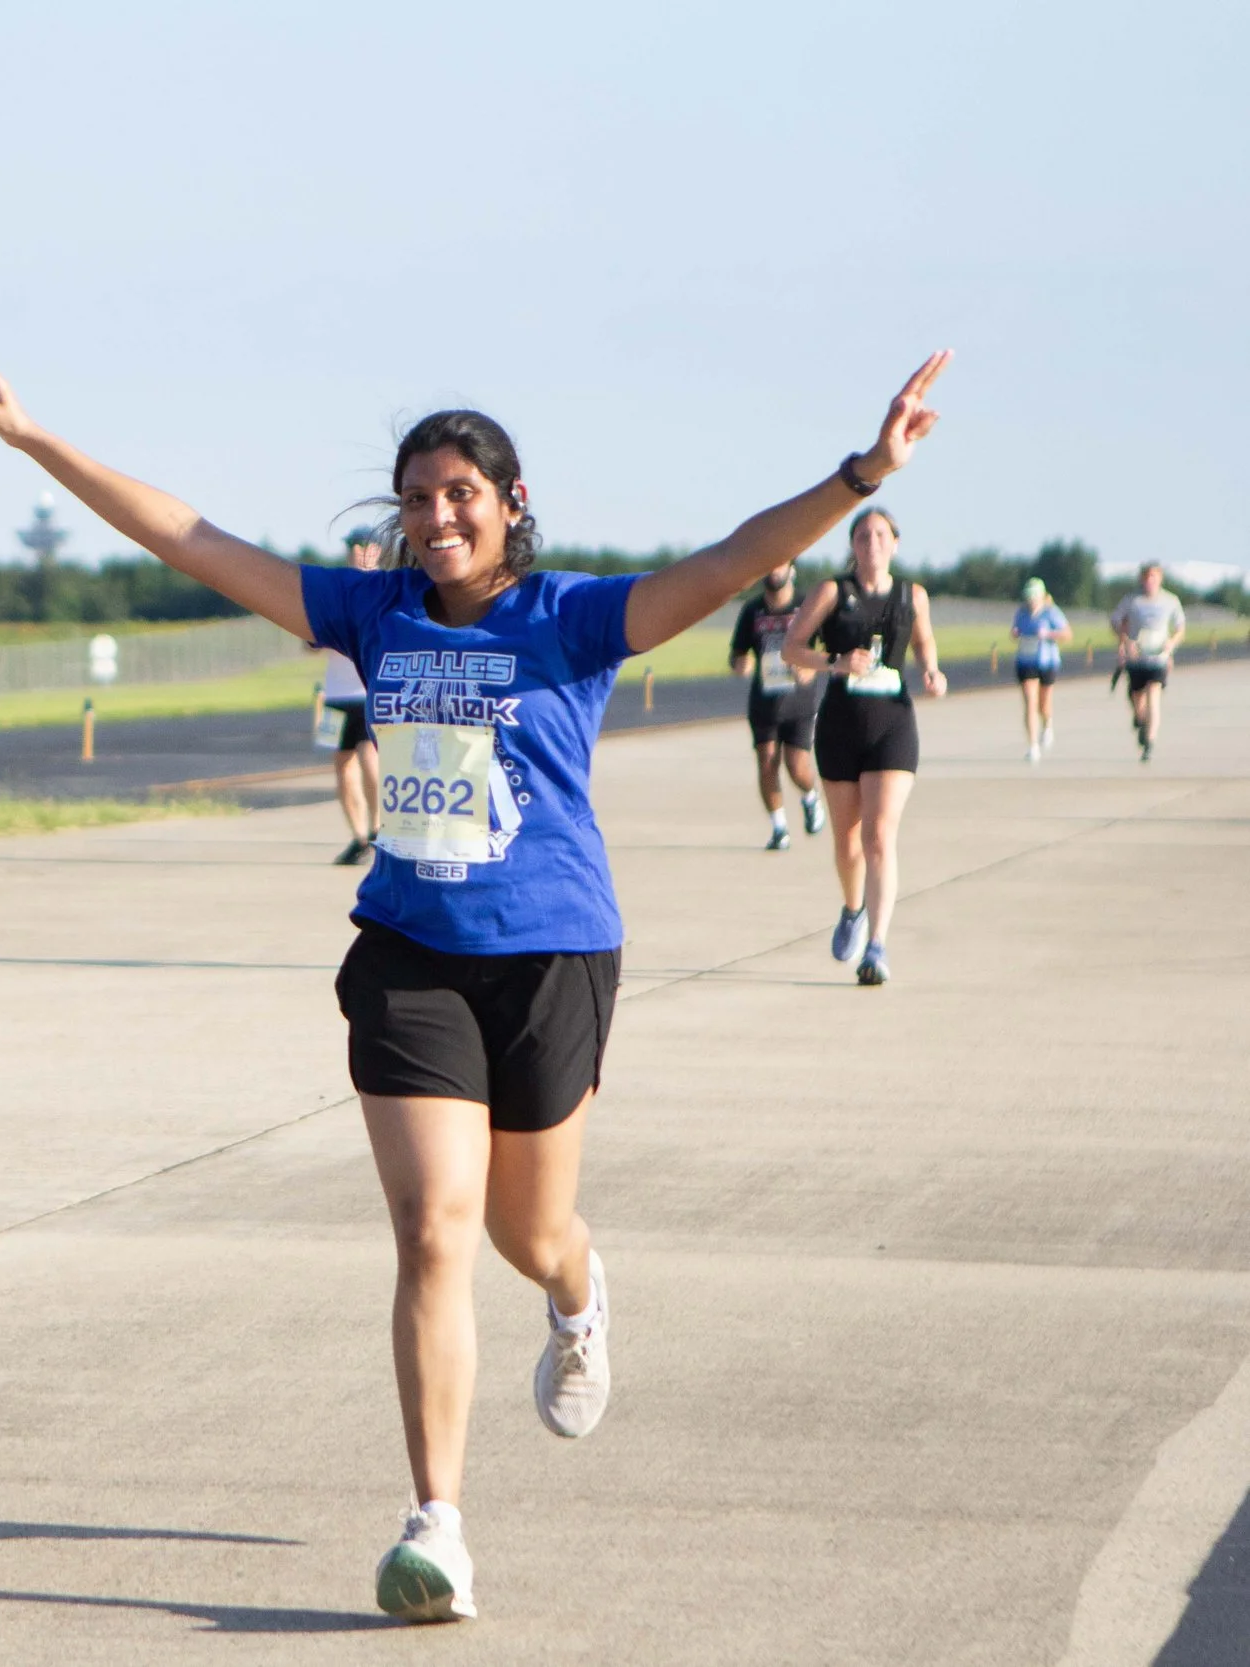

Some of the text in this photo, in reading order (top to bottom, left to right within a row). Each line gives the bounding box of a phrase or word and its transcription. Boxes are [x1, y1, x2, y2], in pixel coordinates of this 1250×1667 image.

[378, 651, 516, 685] DULLES
[374, 693, 522, 725] 5K 10K
[382, 775, 475, 815] 3262
